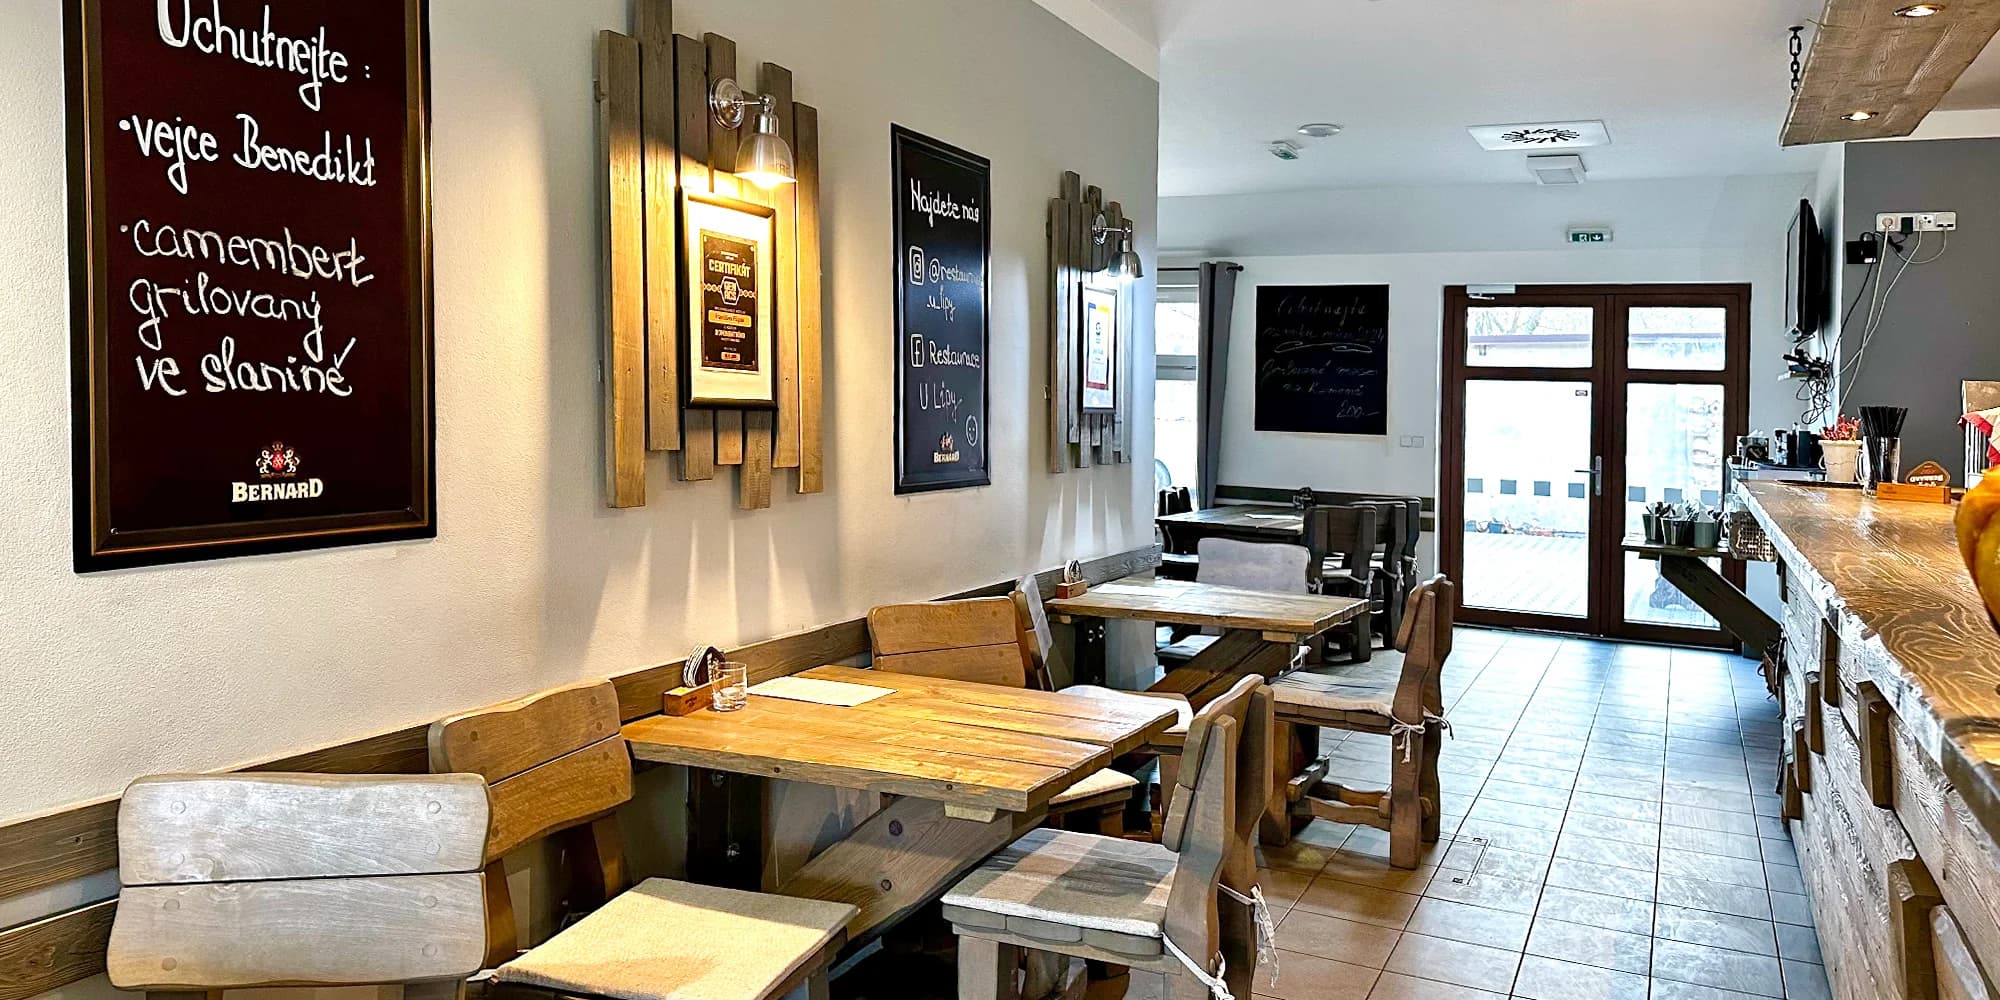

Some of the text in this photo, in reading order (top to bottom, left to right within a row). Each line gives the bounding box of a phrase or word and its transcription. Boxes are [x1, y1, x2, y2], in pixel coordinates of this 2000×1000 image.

[131, 113, 377, 195] vejce Benedikt
[910, 177, 979, 228] Najdete nás
[133, 219, 375, 287] camembert
[708, 259, 751, 278] CERTIFIKÁT
[129, 271, 322, 363] grilovaný
[135, 355, 188, 397] ve
[929, 340, 981, 369] Restaurace
[919, 380, 963, 424] U Lipy
[231, 478, 324, 503] BERNARD
